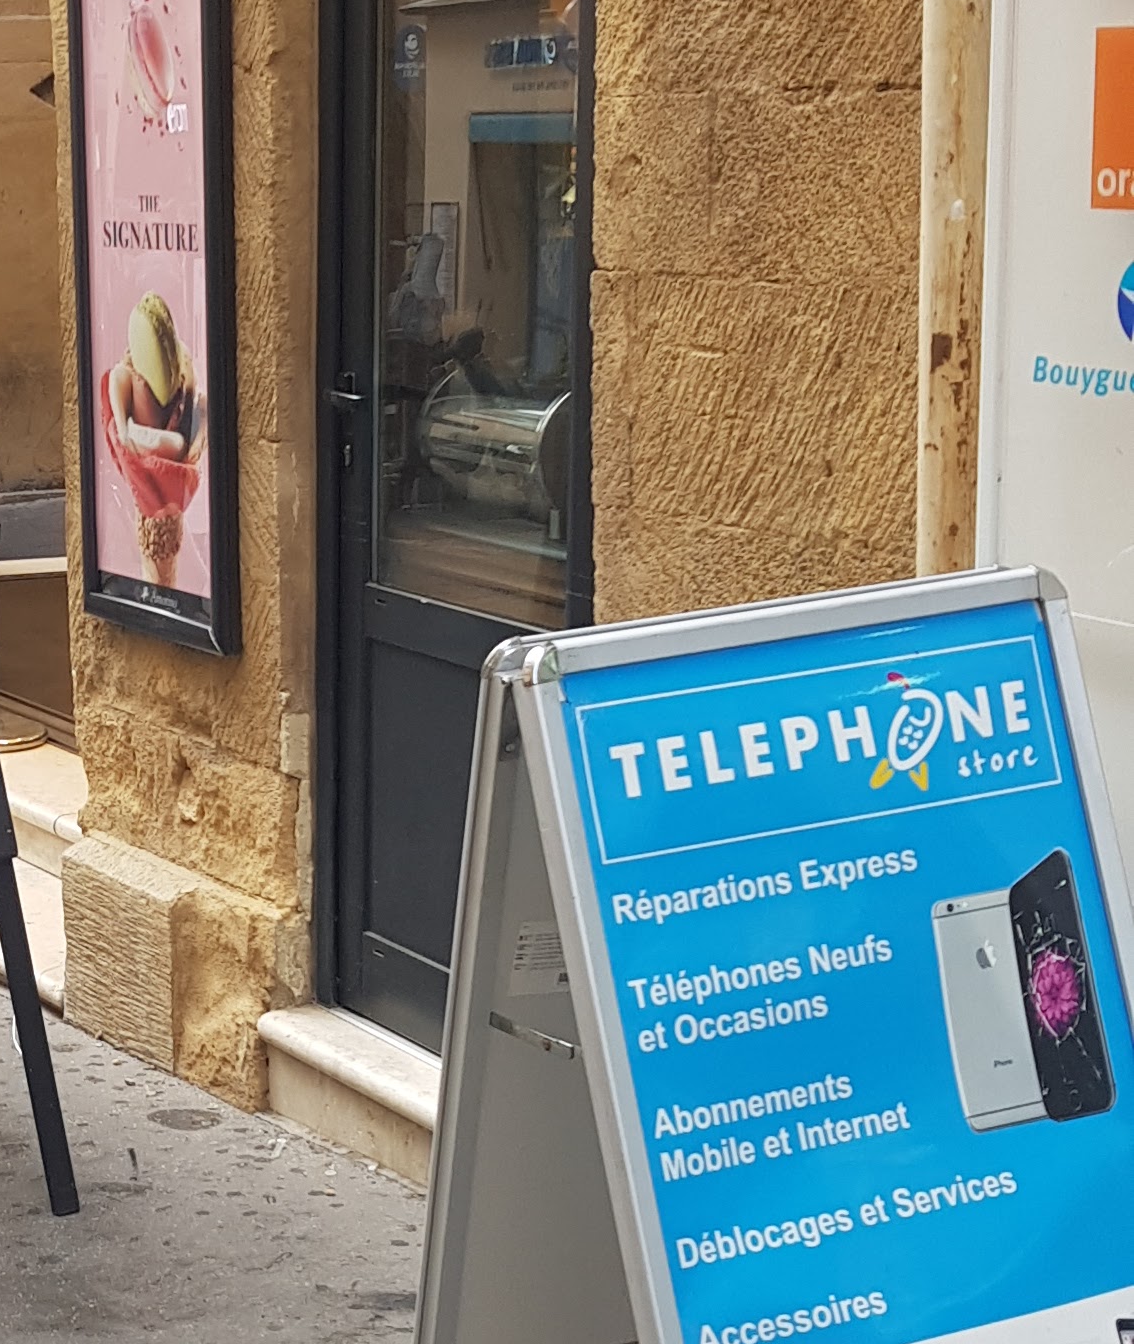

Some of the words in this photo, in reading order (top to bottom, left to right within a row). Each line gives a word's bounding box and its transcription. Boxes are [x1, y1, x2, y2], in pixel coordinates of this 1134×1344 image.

[138, 194, 162, 214] THE
[1096, 167, 1134, 197] or
[102, 220, 200, 253] SIGNATURE
[610, 679, 1032, 799] TELEPHONE
[957, 744, 1040, 778] store
[612, 867, 792, 926] Réparations
[799, 847, 919, 892] Express
[628, 956, 802, 1010] Téléphones
[808, 933, 893, 975] Neufs
[638, 1022, 668, 1053] et
[673, 992, 829, 1046] Occasions
[654, 1072, 854, 1139] Abonnements
[660, 1137, 757, 1182] Mobile
[763, 1128, 793, 1157] et
[799, 1102, 911, 1152] Internet
[676, 1203, 854, 1270] Déblocages
[859, 1194, 891, 1227] et
[892, 1169, 1018, 1218] Services
